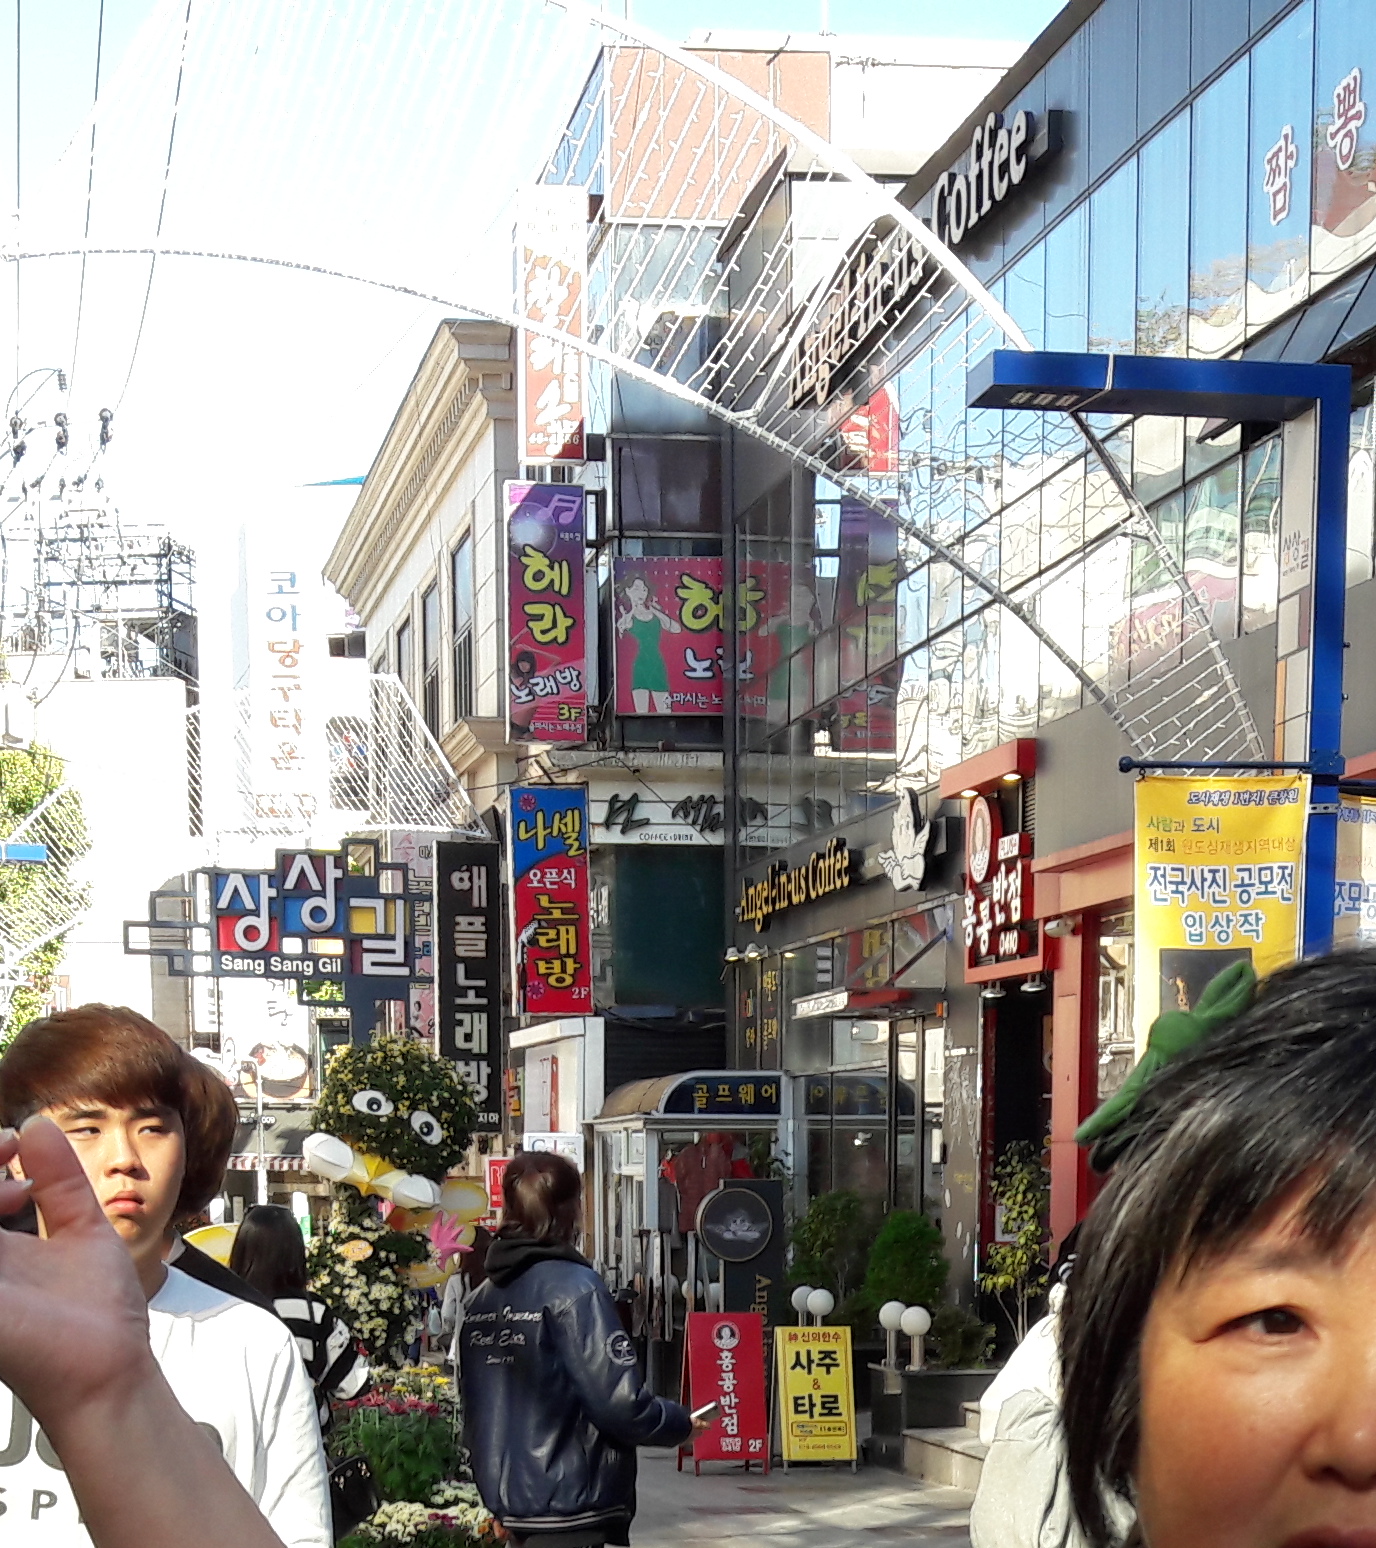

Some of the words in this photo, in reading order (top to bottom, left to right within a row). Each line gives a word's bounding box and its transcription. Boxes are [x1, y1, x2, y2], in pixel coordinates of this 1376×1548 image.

[932, 110, 1028, 246] Coffee
[511, 666, 584, 705] 노래방
[558, 703, 583, 722] 3F
[1188, 789, 1231, 806] 도시재생
[518, 807, 585, 858] 나셀
[1146, 815, 1186, 834] 사람과
[1191, 816, 1221, 834] 도시
[1147, 837, 1176, 854] 제1회
[527, 867, 575, 889] 오픈식
[738, 863, 807, 933] Angel-in-us
[808, 837, 850, 898] Coffee
[1147, 863, 1229, 907] 전국사진
[1233, 863, 1297, 907] 공모전
[216, 853, 411, 976] 상상길
[1183, 909, 1266, 945] 입상작
[534, 893, 581, 988] 노래방
[221, 954, 266, 975] Sang
[270, 955, 314, 976] Sang
[318, 954, 342, 974] Gil
[571, 986, 589, 1000] 2F
[691, 1082, 778, 1107] 골프웨어
[790, 1349, 840, 1375] 사주
[812, 1378, 821, 1390] &
[792, 1393, 843, 1419] 타로
[748, 1438, 763, 1453] 2F
